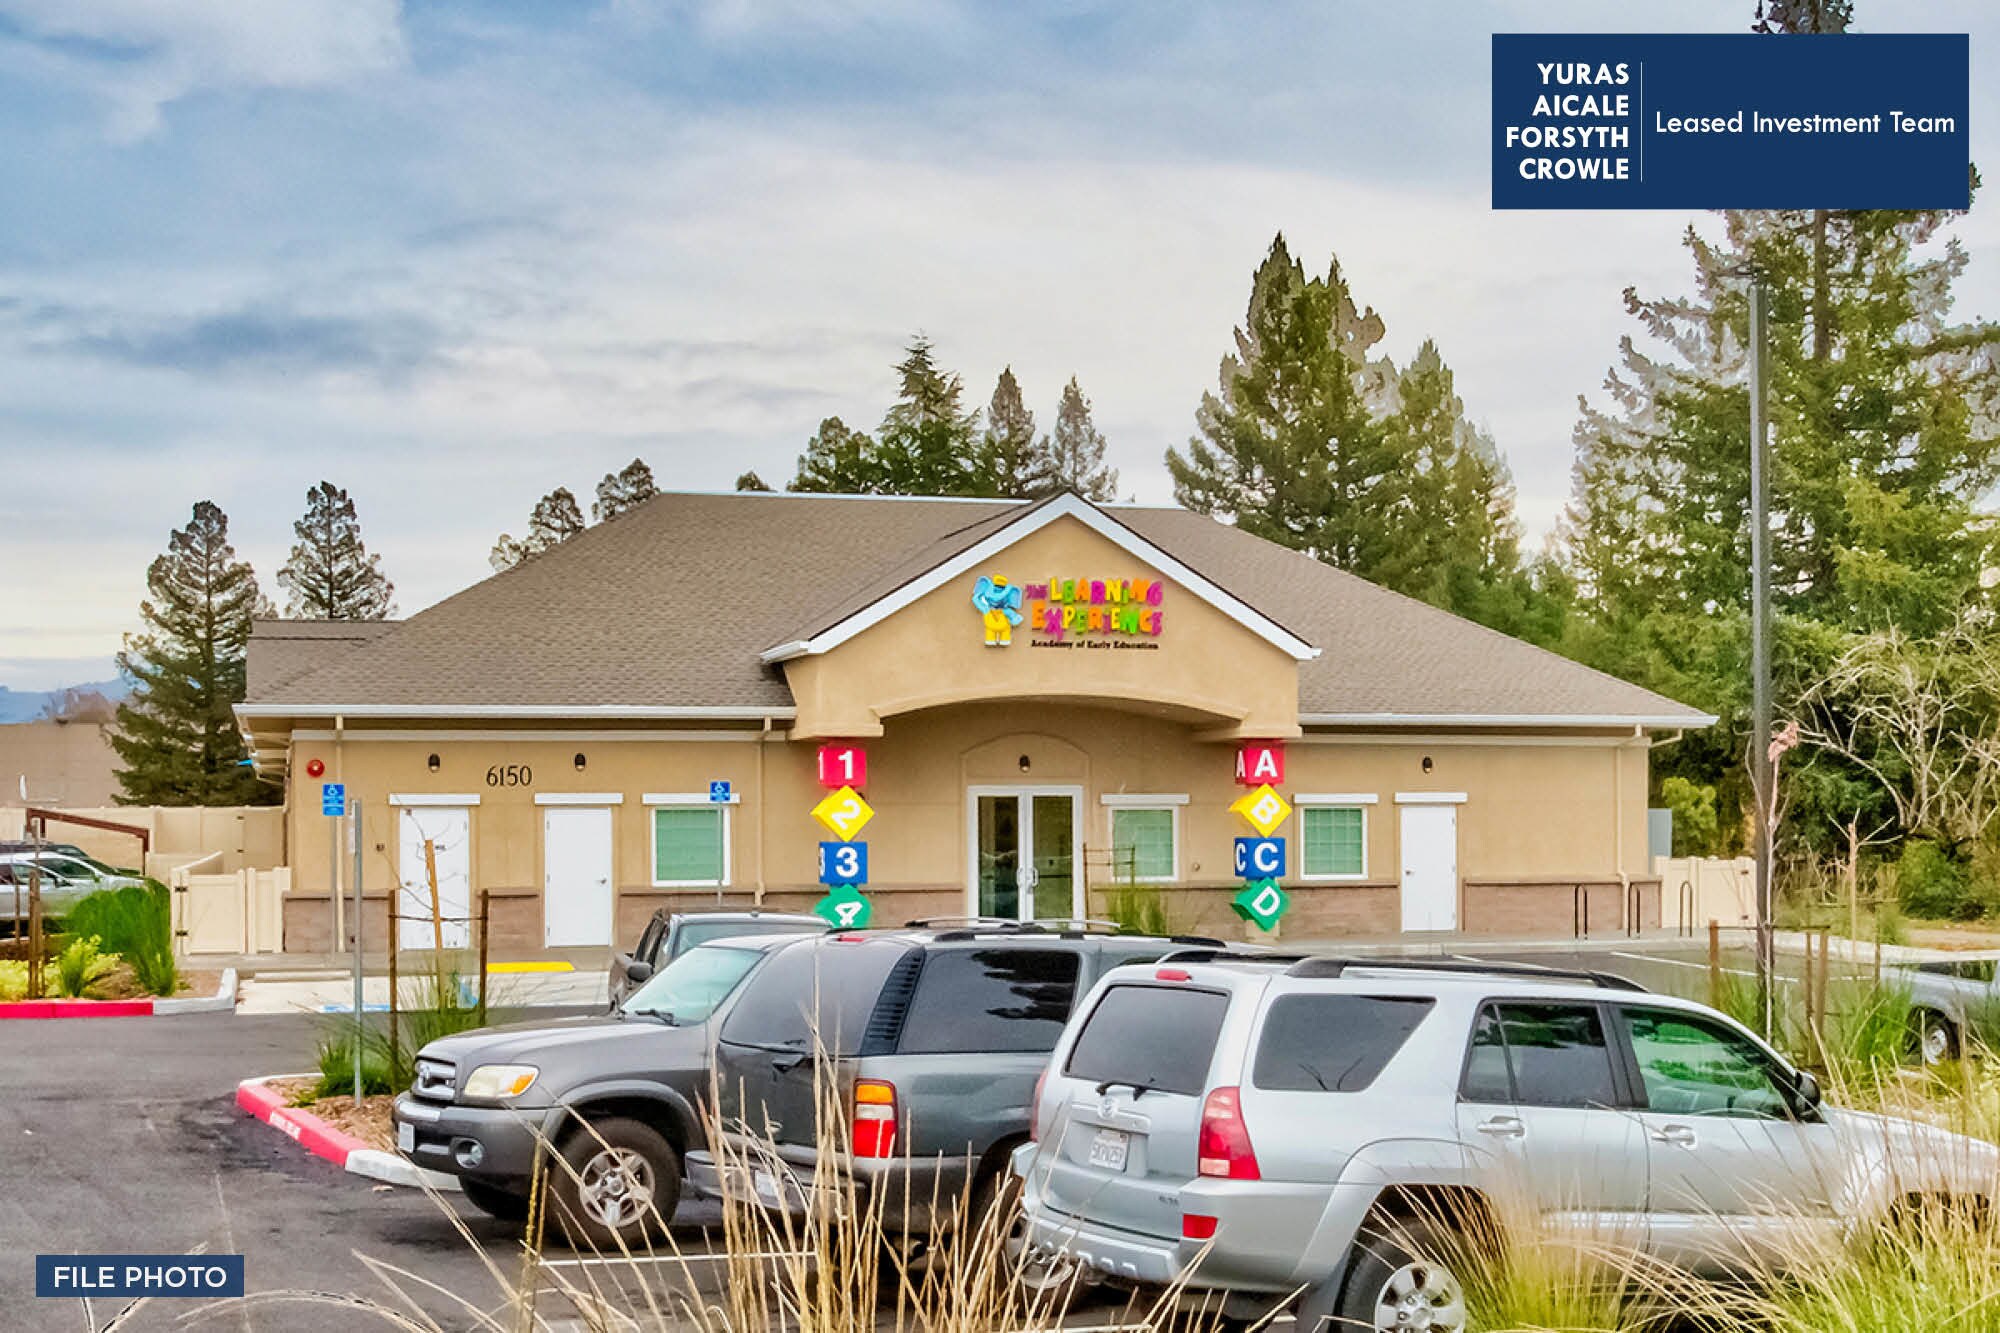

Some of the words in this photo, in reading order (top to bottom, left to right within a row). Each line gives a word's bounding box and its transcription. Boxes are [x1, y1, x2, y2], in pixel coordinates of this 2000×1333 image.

[1031, 639, 1073, 650] Academy
[1076, 640, 1085, 648] of
[1087, 640, 1111, 649] Early
[1113, 641, 1159, 649] Education
[486, 765, 533, 787] 6150
[838, 750, 853, 780] 1
[1236, 751, 1246, 777] A
[1254, 749, 1278, 778] A
[831, 799, 861, 831] 2
[1251, 793, 1281, 825] B
[835, 847, 860, 878] 3
[1236, 843, 1247, 872] C
[1254, 842, 1279, 872] C
[834, 901, 863, 927] 4
[1251, 885, 1281, 916] D
